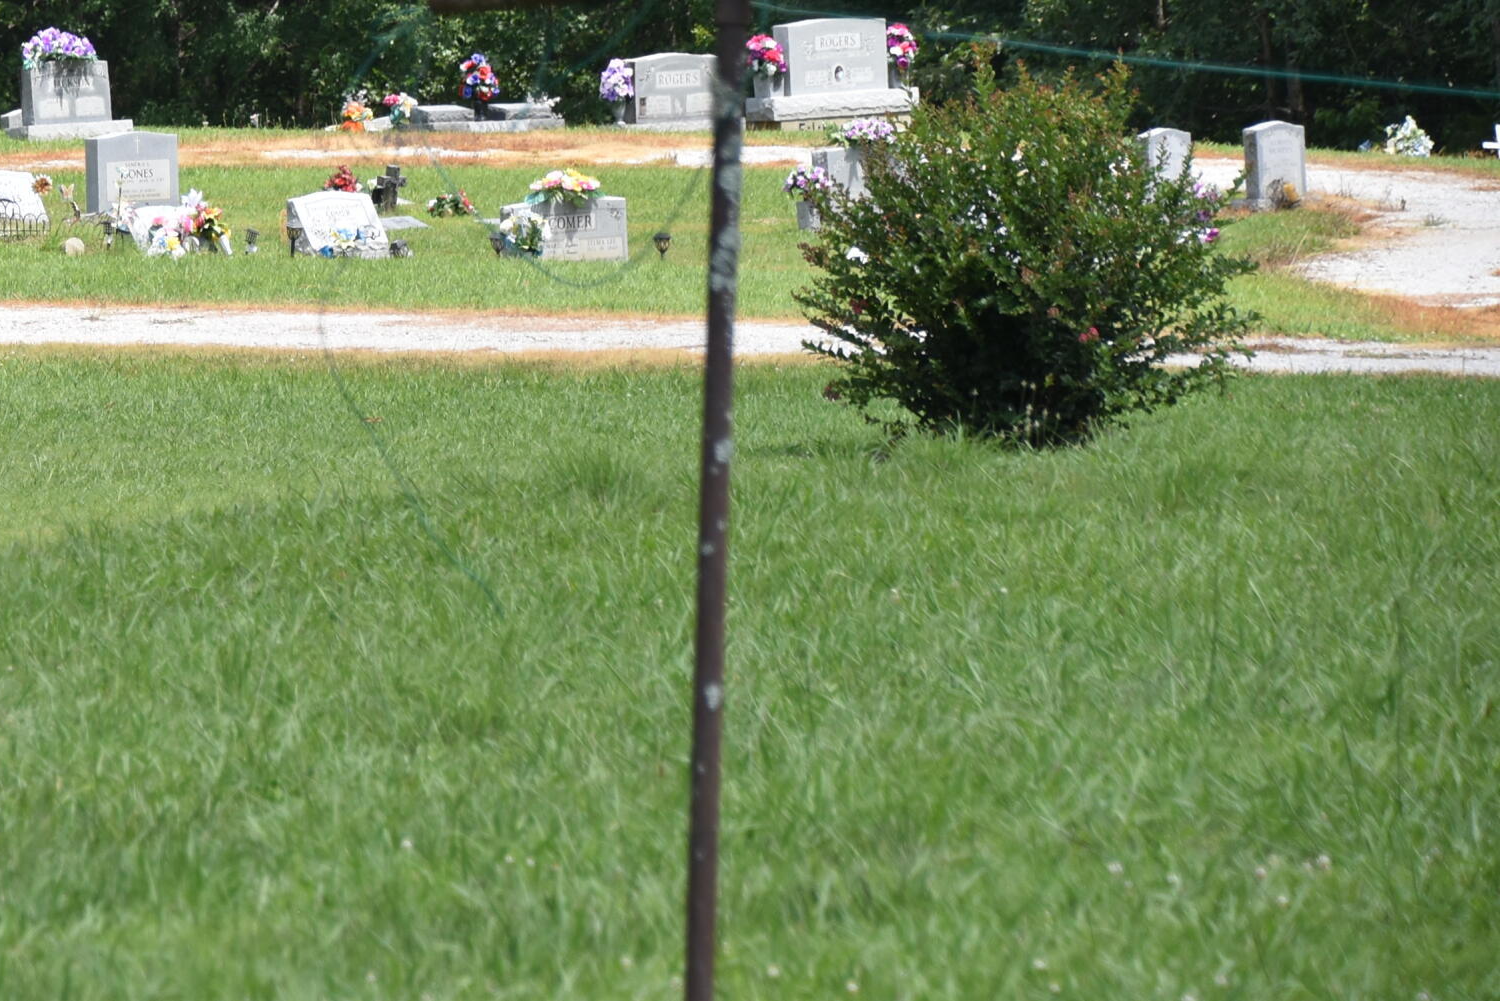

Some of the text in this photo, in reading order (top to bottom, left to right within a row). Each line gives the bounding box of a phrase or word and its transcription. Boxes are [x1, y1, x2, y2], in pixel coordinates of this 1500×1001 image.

[819, 35, 856, 48] ROGERS
[659, 72, 698, 85] ROGERS
[549, 215, 592, 230] COMER
